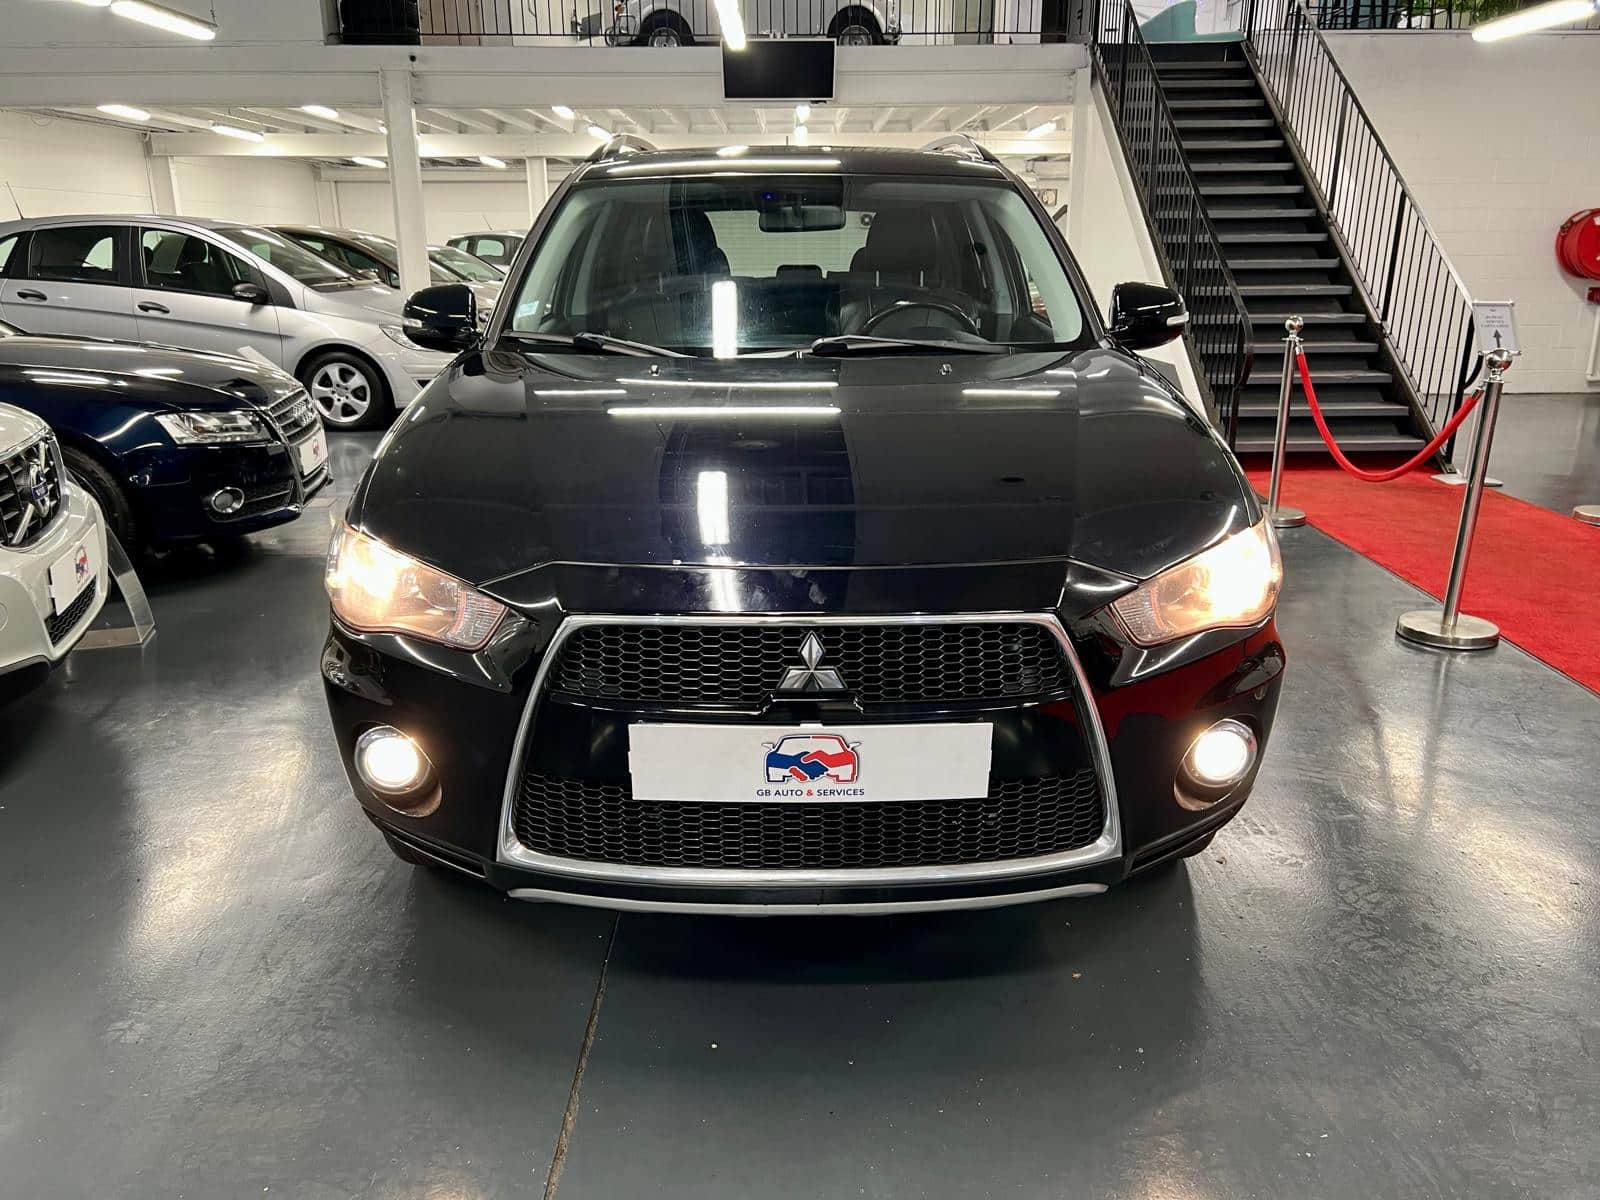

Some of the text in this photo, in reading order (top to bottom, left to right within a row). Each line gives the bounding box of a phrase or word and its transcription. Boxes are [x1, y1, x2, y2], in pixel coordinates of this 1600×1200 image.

[756, 788, 865, 797] GB AUTO & SERVICES
